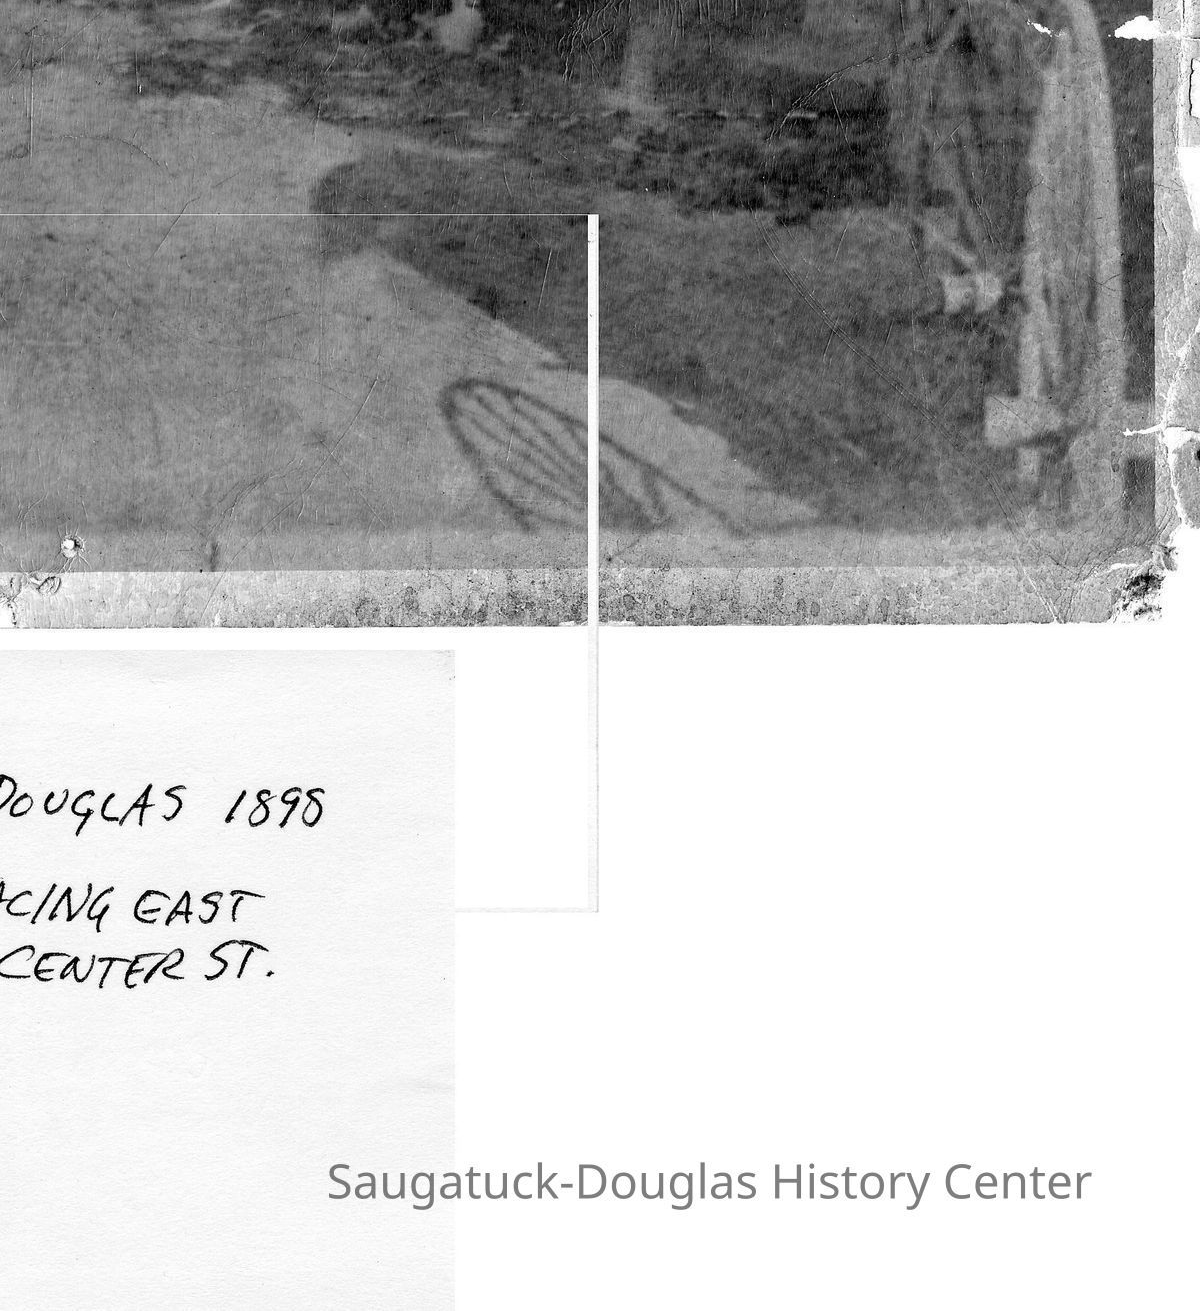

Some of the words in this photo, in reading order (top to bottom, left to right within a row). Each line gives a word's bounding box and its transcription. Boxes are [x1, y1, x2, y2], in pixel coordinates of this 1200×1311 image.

[224, 786, 326, 829] 1898
[133, 889, 266, 927] EAST
[203, 939, 275, 981] ST.
